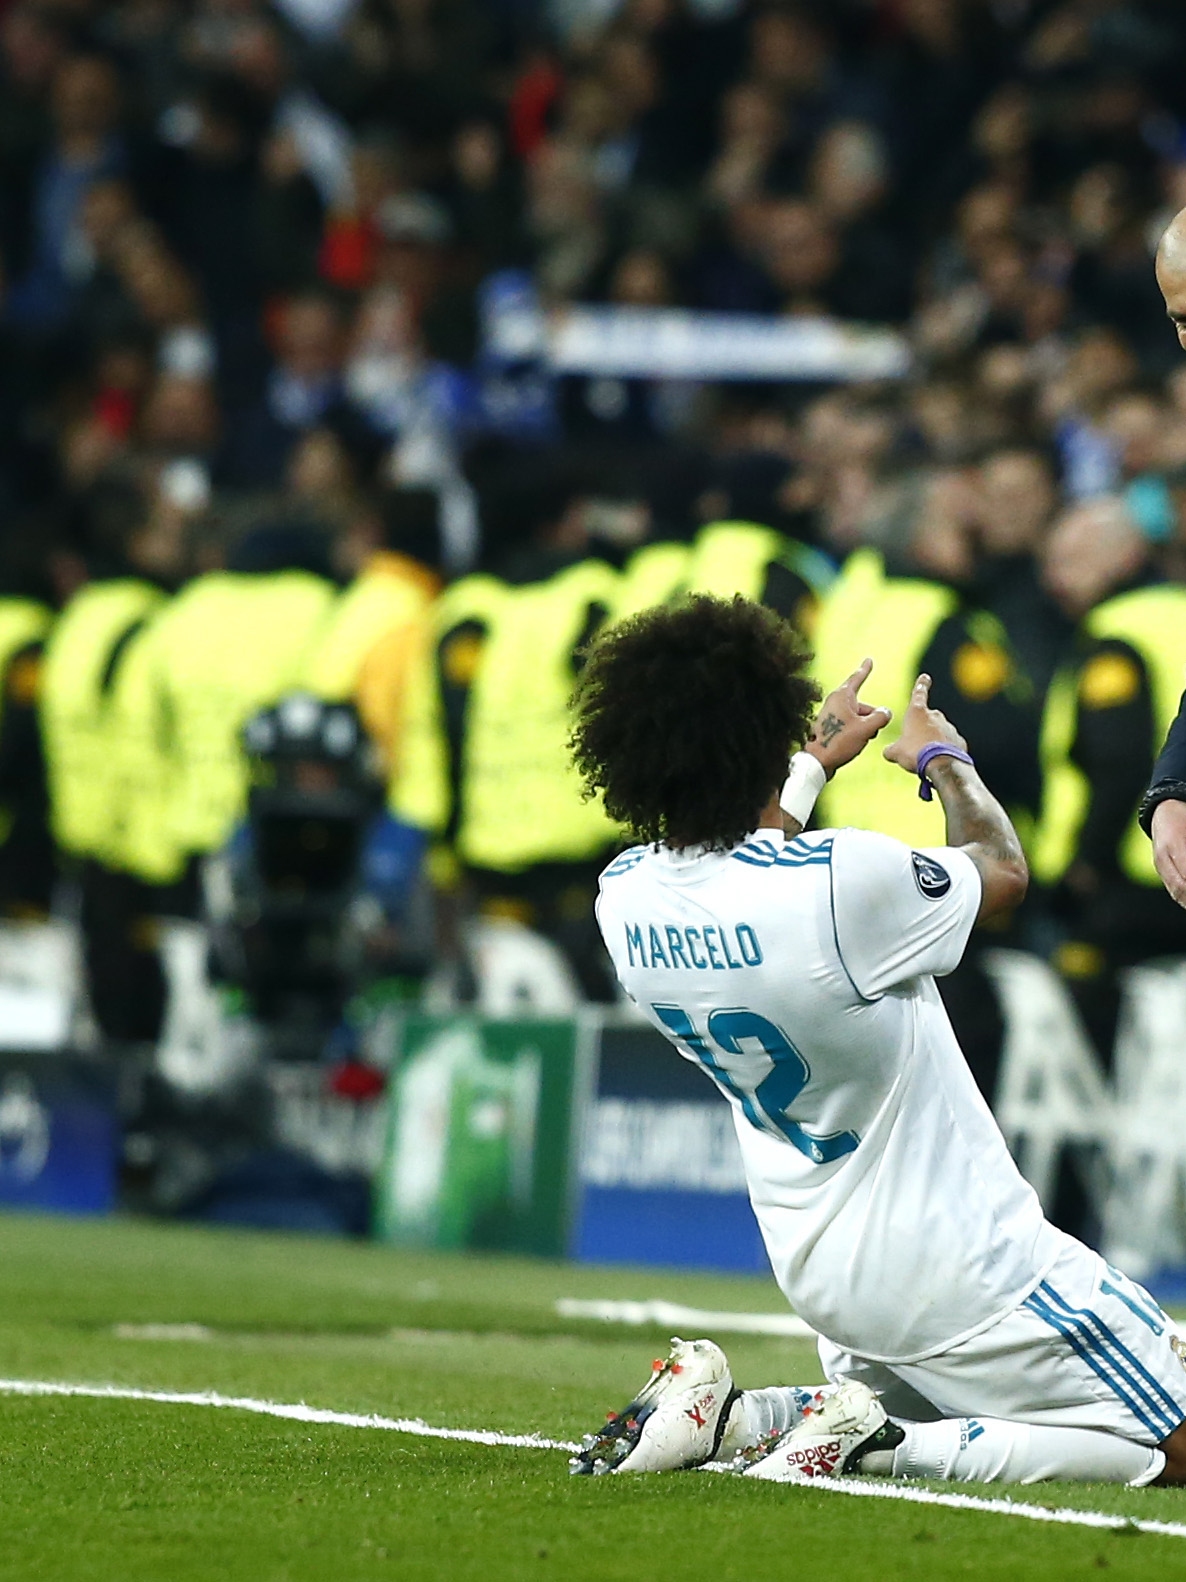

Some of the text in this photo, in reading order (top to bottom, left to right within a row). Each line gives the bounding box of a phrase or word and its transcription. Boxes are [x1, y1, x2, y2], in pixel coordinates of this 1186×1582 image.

[624, 921, 764, 970] MARCELO
[650, 1002, 862, 1165] 12
[786, 1441, 841, 1467] adidas
